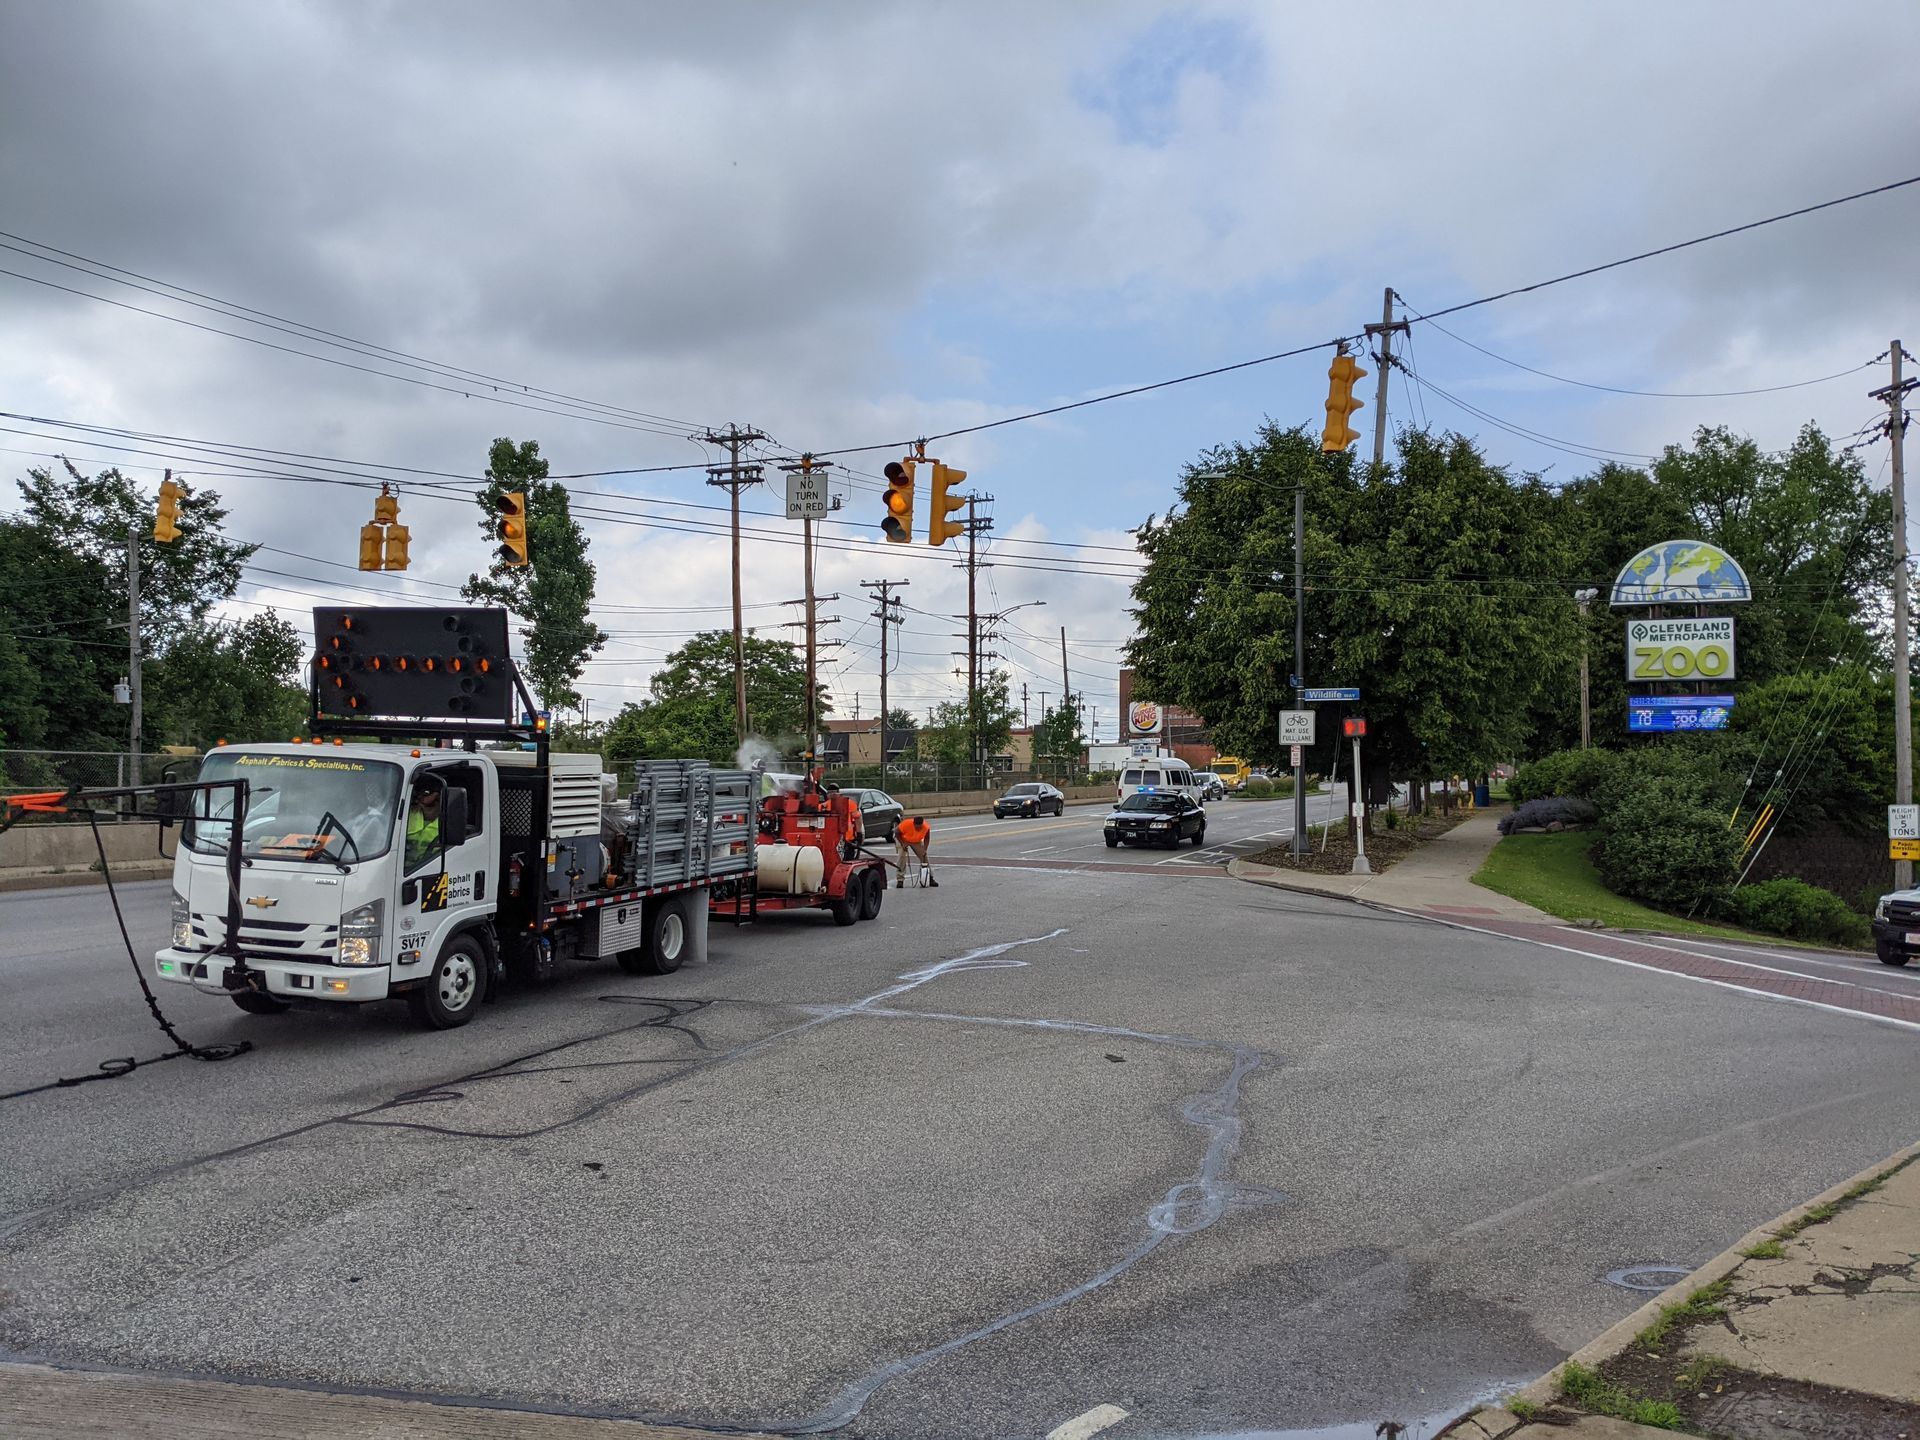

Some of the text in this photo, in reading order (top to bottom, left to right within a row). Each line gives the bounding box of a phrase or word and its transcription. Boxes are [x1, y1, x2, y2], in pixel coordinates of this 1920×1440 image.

[800, 481, 813, 489] NO
[796, 492, 818, 500] TURN
[790, 503, 823, 512] ON RED
[1650, 622, 1730, 633] CLEVELAND
[1650, 632, 1730, 642] METROPARKS
[1635, 645, 1728, 678] ZOO
[1309, 690, 1342, 699] Wildlife
[1134, 713, 1156, 724] KING
[236, 756, 267, 765] Asphalt
[268, 756, 300, 766] Fabrics
[306, 759, 350, 771] Specialties,
[402, 936, 426, 950] SV17
